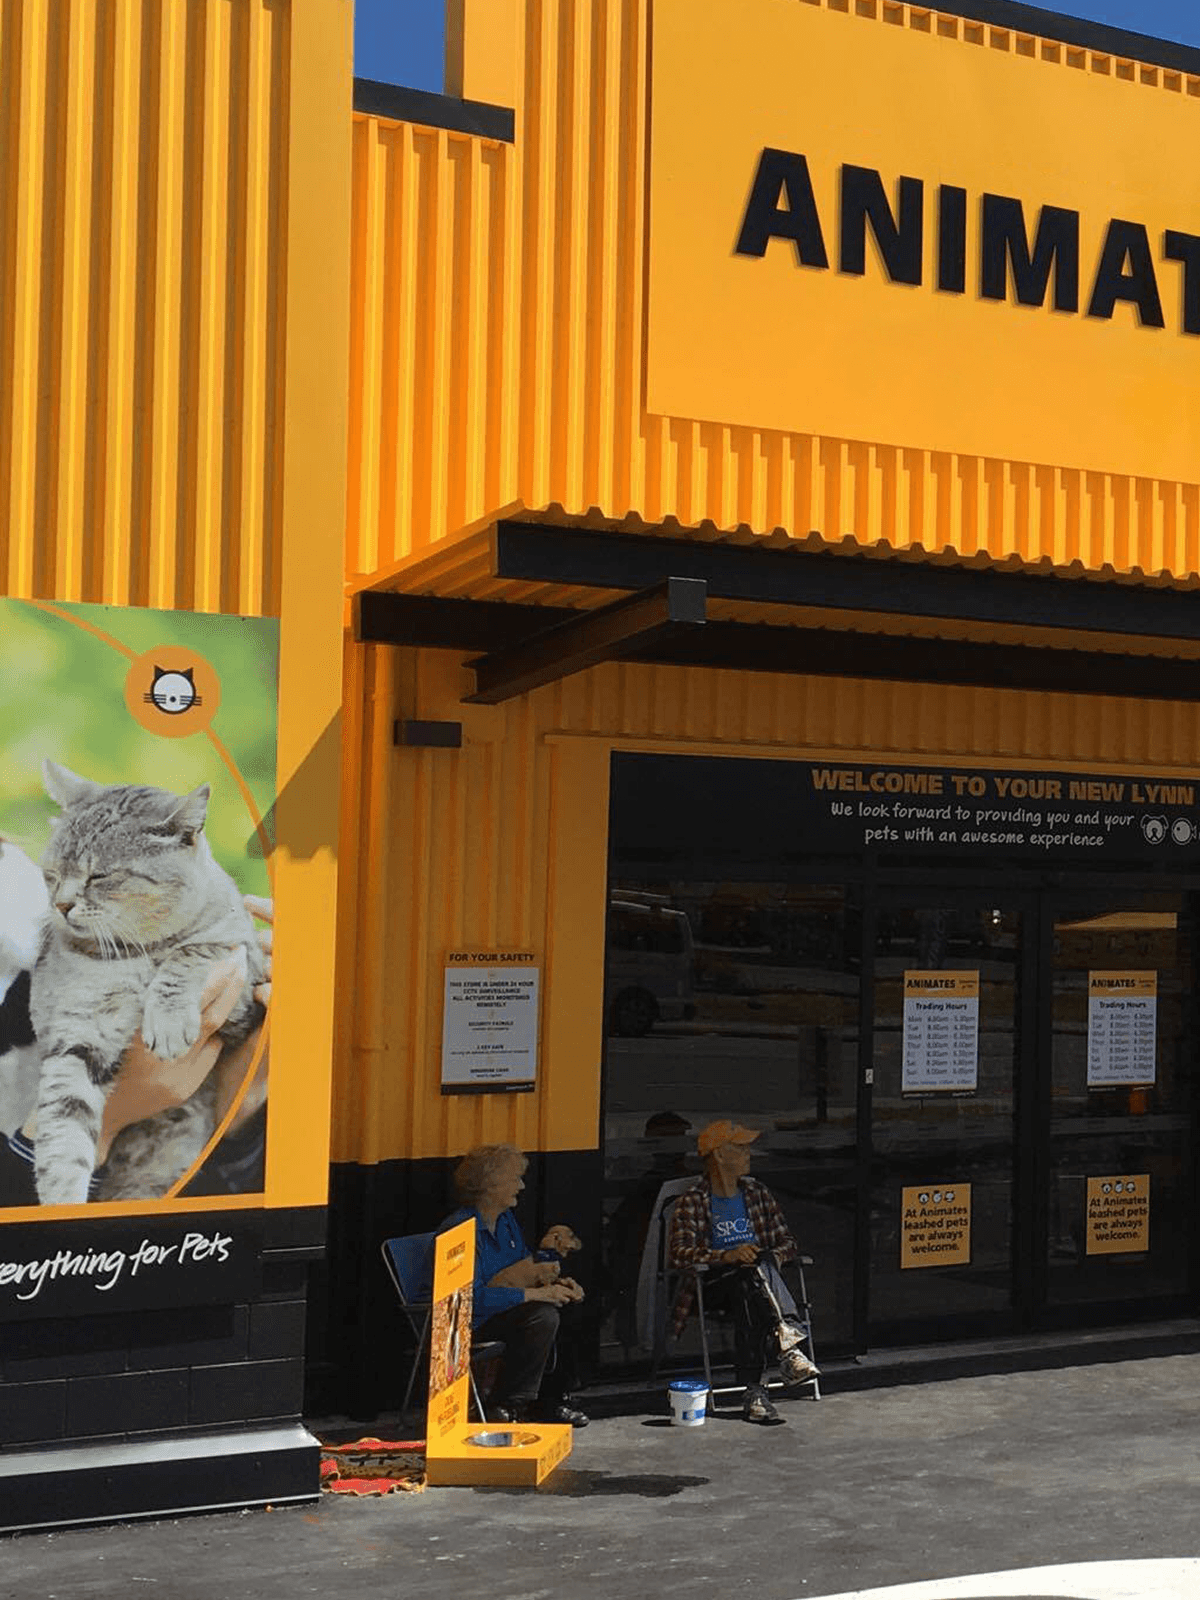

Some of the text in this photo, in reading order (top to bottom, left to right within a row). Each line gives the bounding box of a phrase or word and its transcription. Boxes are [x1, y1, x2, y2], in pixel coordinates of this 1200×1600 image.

[811, 769, 943, 794] WELCOME
[951, 776, 986, 796] TO
[994, 778, 1061, 799] YOUR
[1069, 781, 1124, 801] NEW
[1131, 784, 1194, 805] LYNN
[831, 802, 1135, 831] We look forward to providing you and your
[865, 825, 1105, 849] pets with an awesome experience
[450, 953, 535, 962] FOR YOUR SAFETY
[907, 979, 956, 988] ANIMATES
[1091, 979, 1136, 988] ANIMATES
[915, 1003, 944, 1011] Trading
[1099, 1001, 1147, 1010] Trading Hours
[1090, 1196, 1147, 1207] At Animates
[905, 1206, 967, 1218] At Animates
[1089, 1207, 1147, 1219] leashed pets
[904, 1217, 968, 1230] leashed pets
[1110, 1219, 1143, 1229] always
[909, 1230, 963, 1242] are always
[1095, 1230, 1140, 1241] welcome.
[910, 1242, 959, 1253] welcome.
[131, 1239, 178, 1276] for
[178, 1232, 233, 1264] Pets
